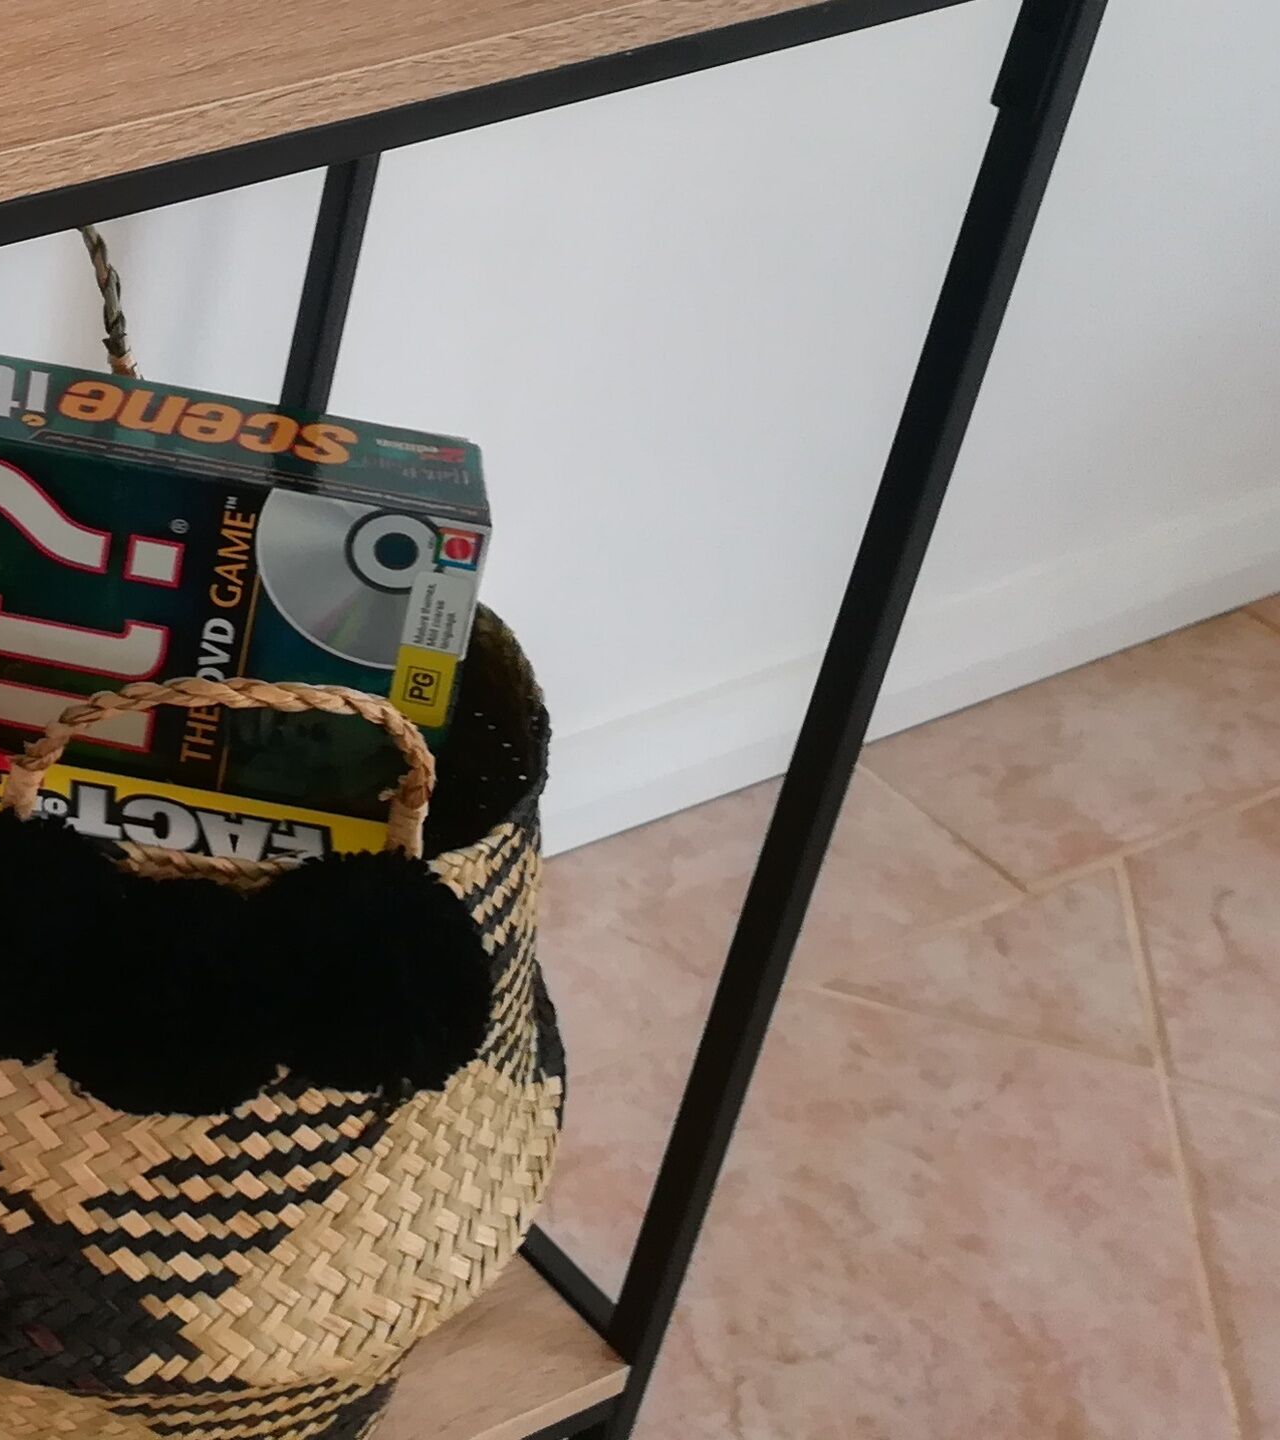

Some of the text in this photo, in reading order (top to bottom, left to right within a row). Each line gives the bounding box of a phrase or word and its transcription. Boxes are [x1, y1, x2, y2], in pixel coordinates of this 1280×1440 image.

[56, 379, 360, 465] scene
[408, 671, 434, 701] PG
[65, 784, 327, 861] FACT
